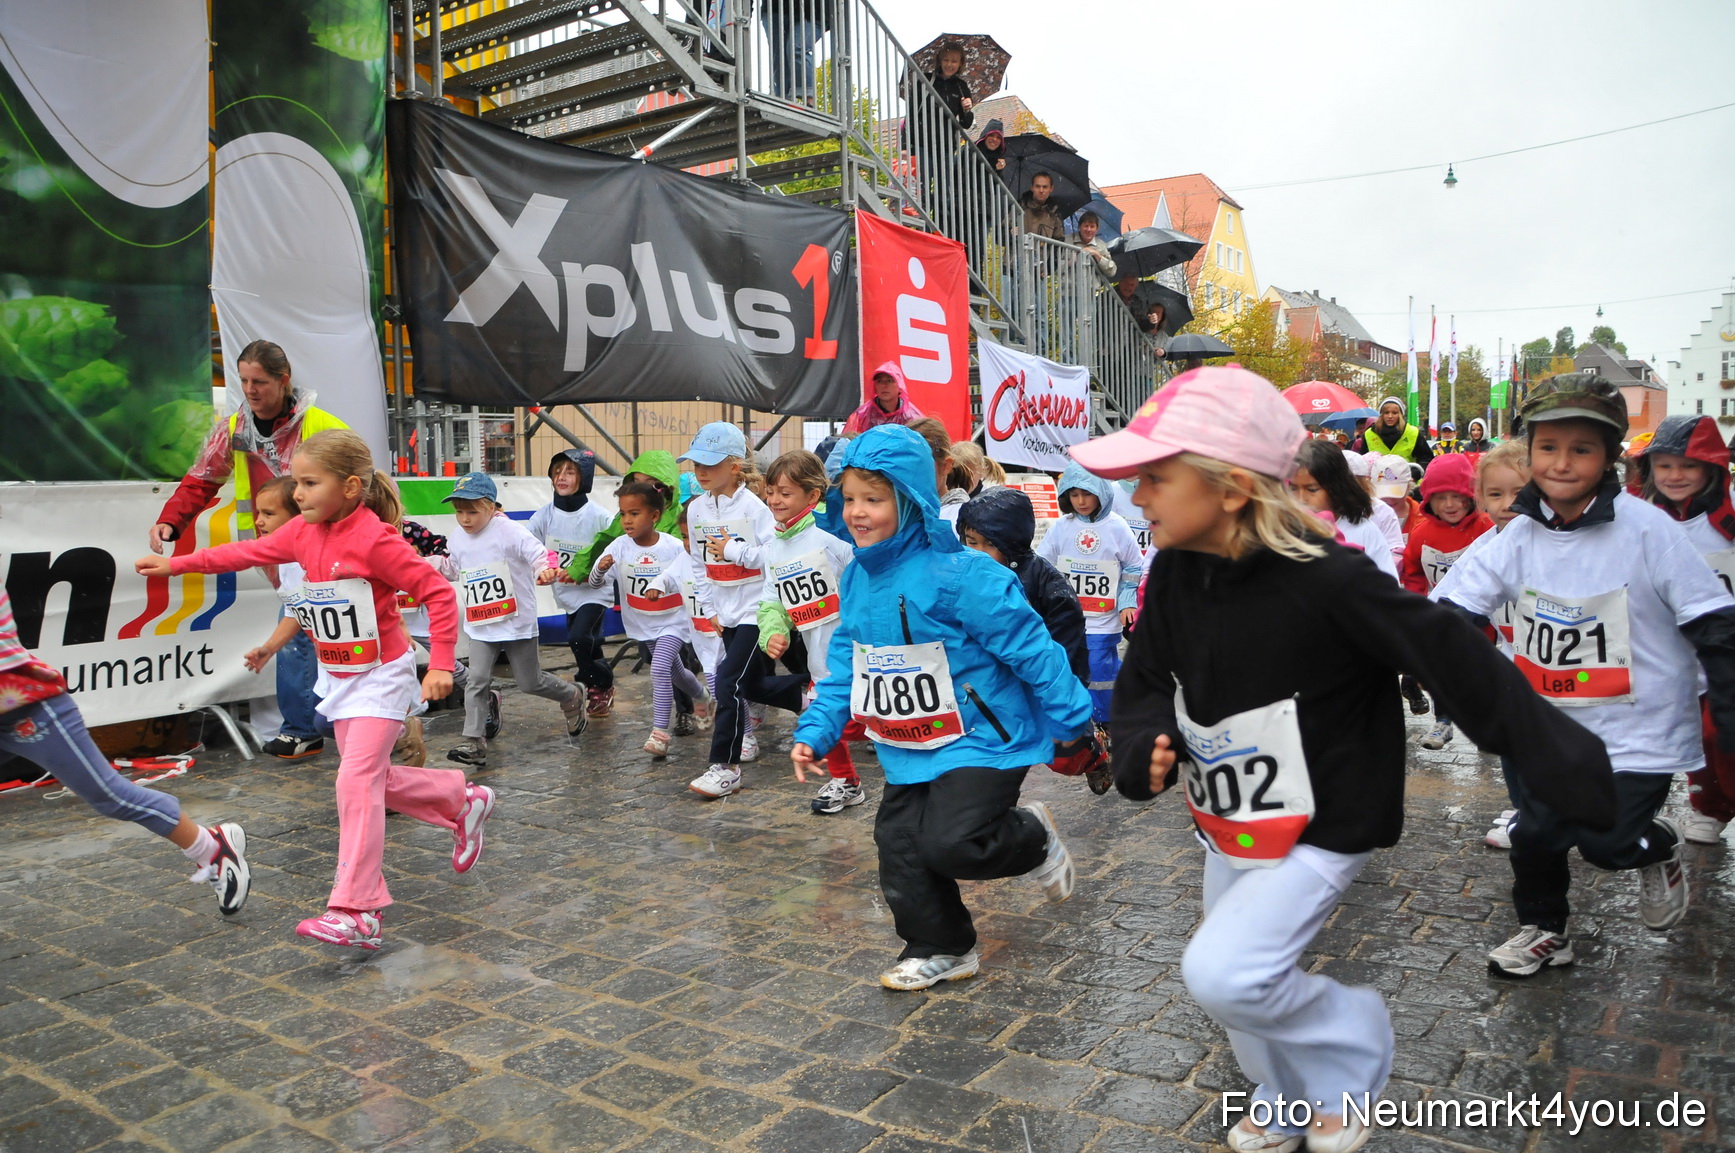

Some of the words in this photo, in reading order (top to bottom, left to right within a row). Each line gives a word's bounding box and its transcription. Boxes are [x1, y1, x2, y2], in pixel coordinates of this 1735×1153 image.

[775, 561, 802, 576] BOCK
[1070, 563, 1098, 571] BOCK
[305, 588, 336, 599] OCK
[464, 577, 507, 606] 7129
[775, 571, 828, 606] 7056
[471, 606, 501, 619] Mirjam
[792, 606, 821, 623] Stella
[1536, 598, 1582, 619] BOCK
[309, 605, 360, 640] 101
[1523, 615, 1607, 666] 7021
[320, 648, 350, 664] venja
[63, 643, 214, 694] umarkt
[1543, 675, 1575, 692] Lea
[861, 673, 940, 716] 7080
[1184, 755, 1284, 818] 302
